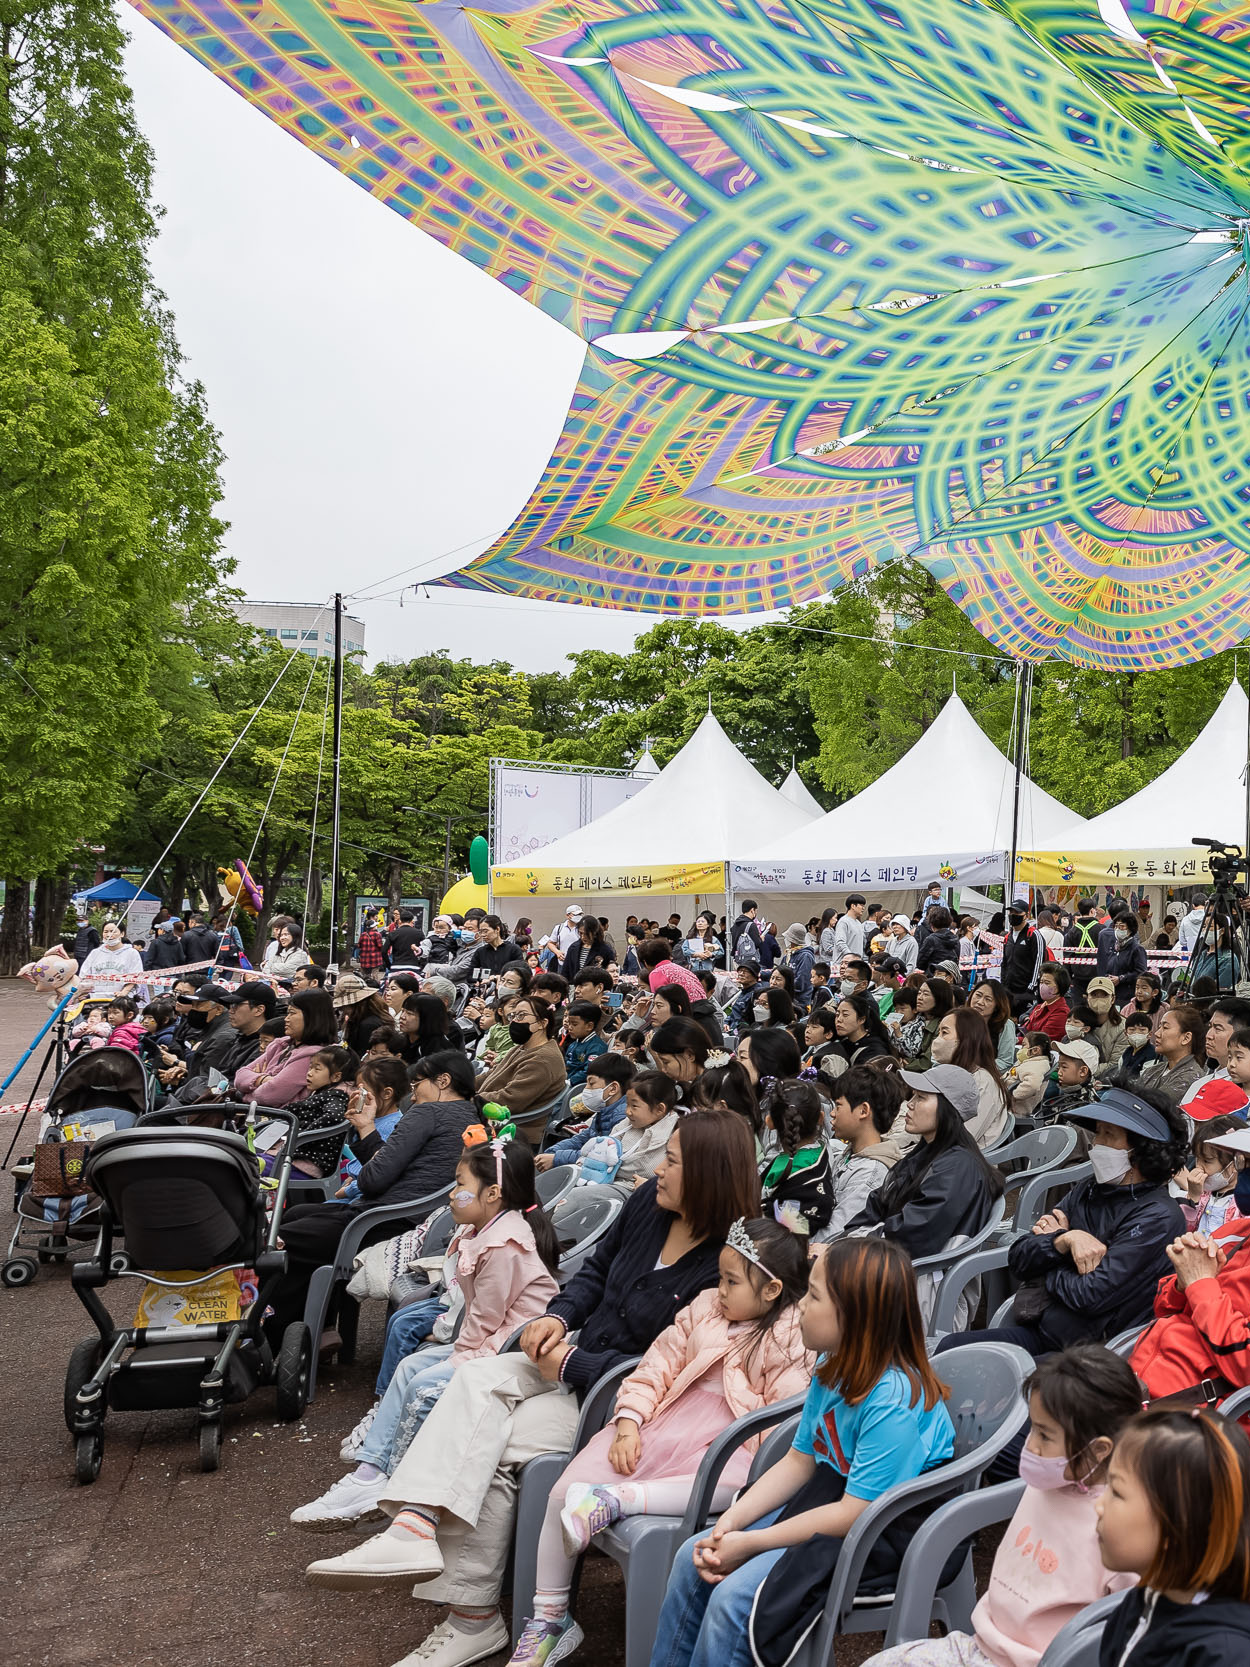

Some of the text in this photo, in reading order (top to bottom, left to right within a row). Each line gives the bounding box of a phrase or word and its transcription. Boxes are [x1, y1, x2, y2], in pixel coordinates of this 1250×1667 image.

[552, 874, 653, 891] 동화 페이스 페인팅
[801, 866, 919, 886] 동화 페이스 페인팅
[188, 1300, 229, 1311] CLEAN
